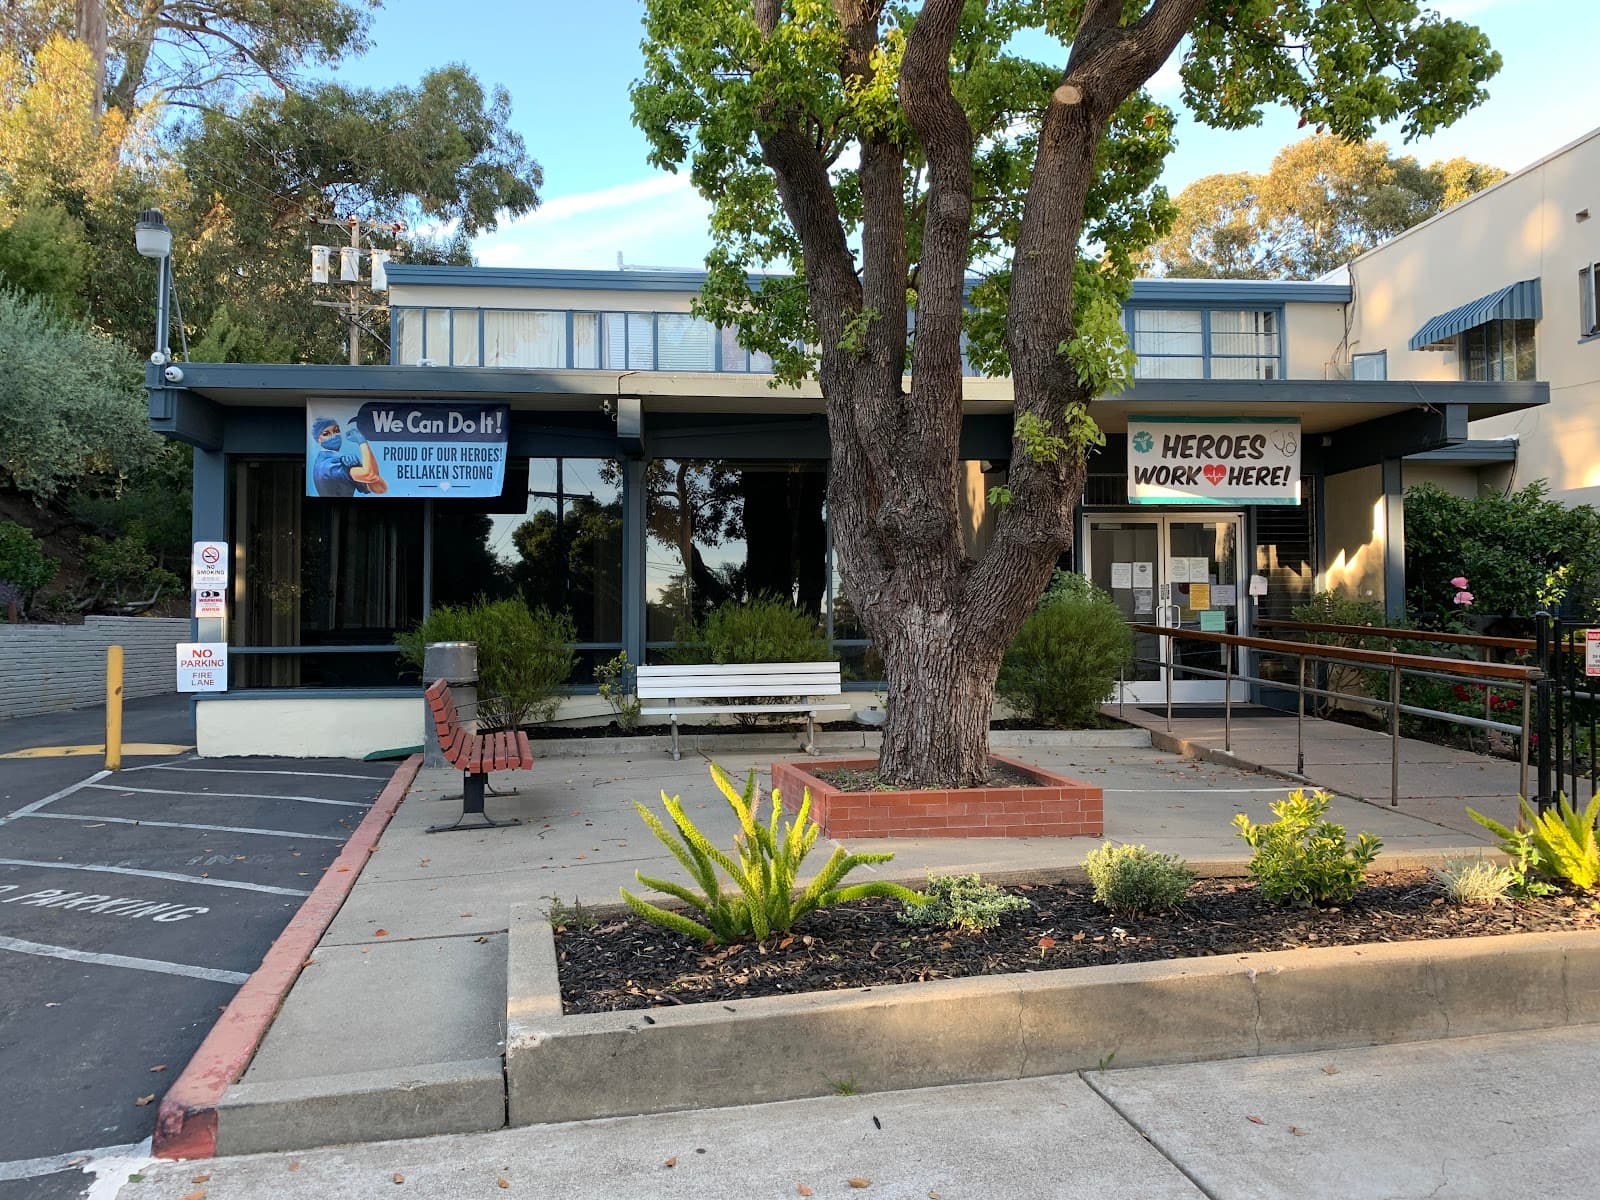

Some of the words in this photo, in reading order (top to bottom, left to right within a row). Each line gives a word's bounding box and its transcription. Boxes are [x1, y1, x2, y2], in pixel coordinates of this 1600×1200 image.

[372, 410, 404, 434] We
[406, 411, 443, 434] Can
[448, 411, 476, 434] Do
[480, 410, 502, 434] It!
[383, 447, 419, 462] PROUD
[421, 447, 434, 462] OF
[437, 447, 457, 462] OUR
[460, 447, 502, 463] HEROES!
[1161, 433, 1267, 460] HEROES
[397, 464, 449, 480] BELLAKEN
[452, 465, 493, 480] STRONG
[1134, 465, 1203, 486] WORK
[1227, 465, 1292, 487] HERE!
[192, 649, 213, 658] NO
[180, 659, 225, 668] PARKING
[2, 888, 210, 922] PARKING
